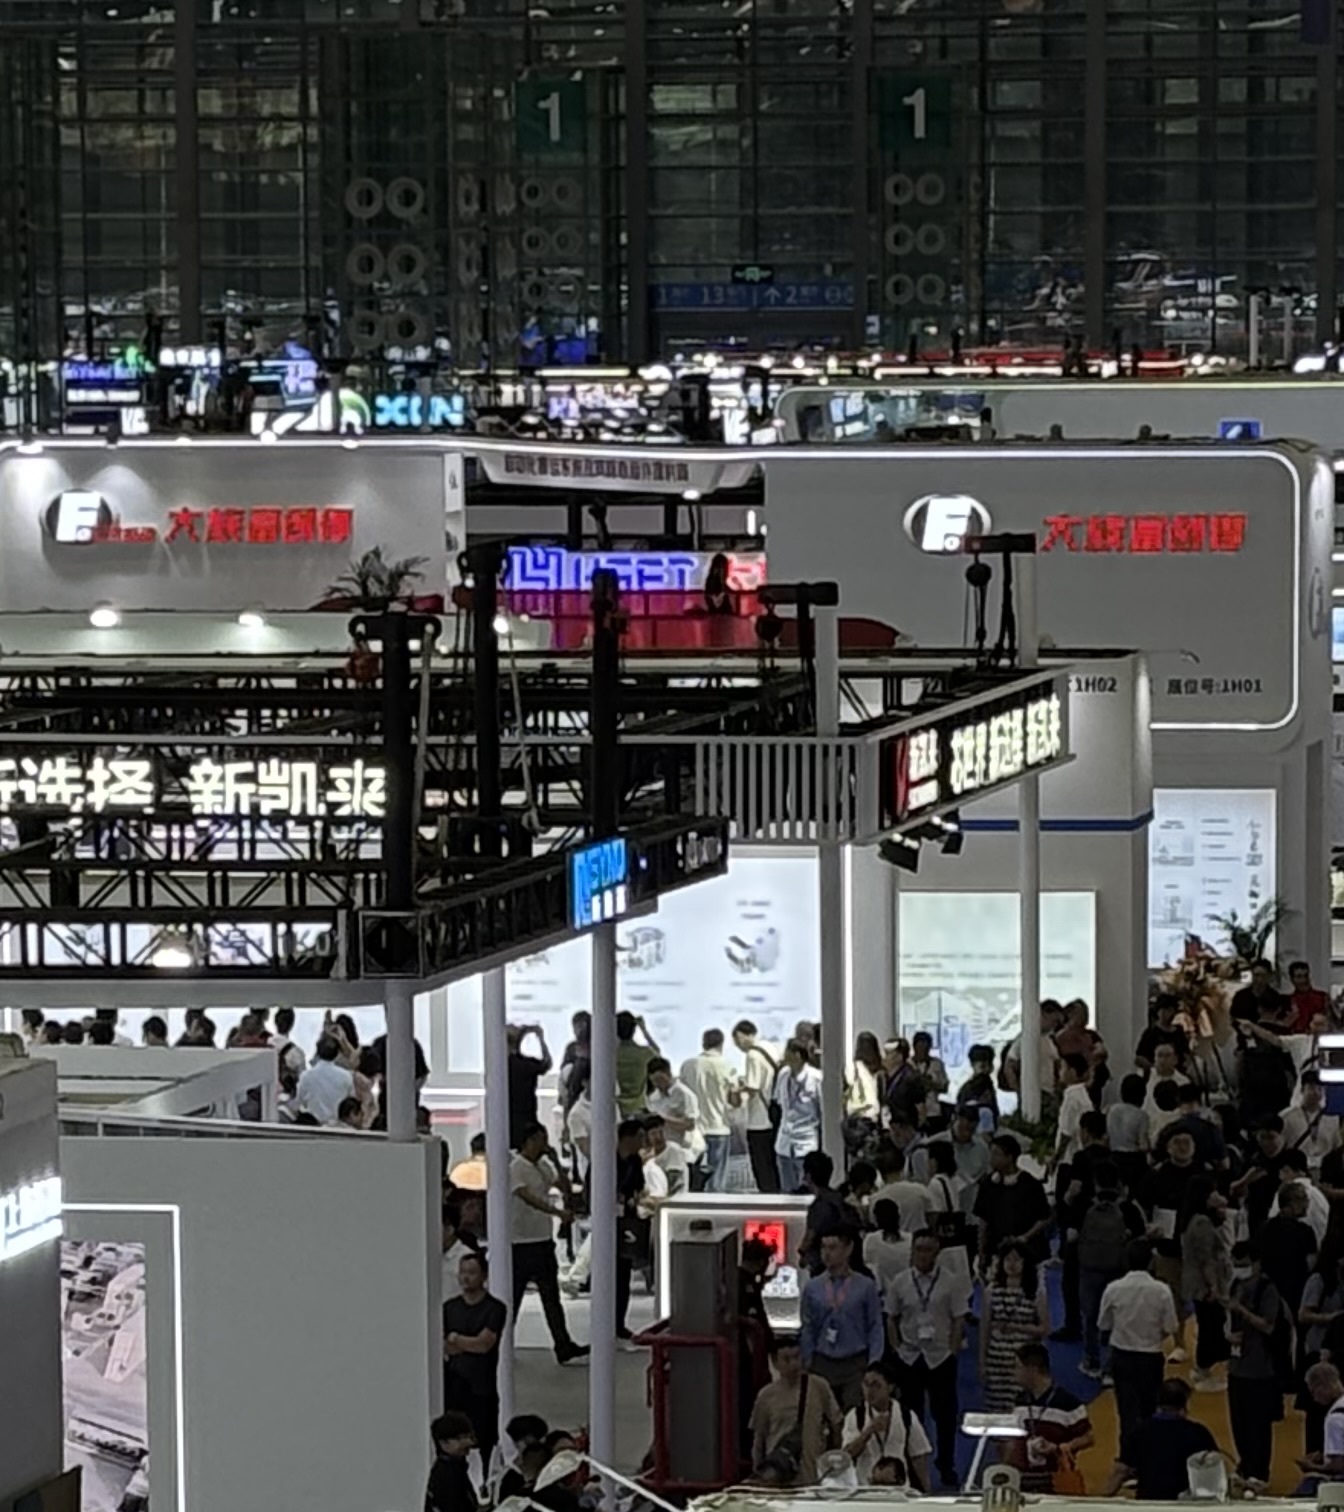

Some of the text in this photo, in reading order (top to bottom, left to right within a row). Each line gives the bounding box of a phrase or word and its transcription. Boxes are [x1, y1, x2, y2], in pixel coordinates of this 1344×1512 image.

[537, 91, 562, 142] 1
[903, 87, 929, 140] 1
[187, 756, 388, 817] 新凯来
